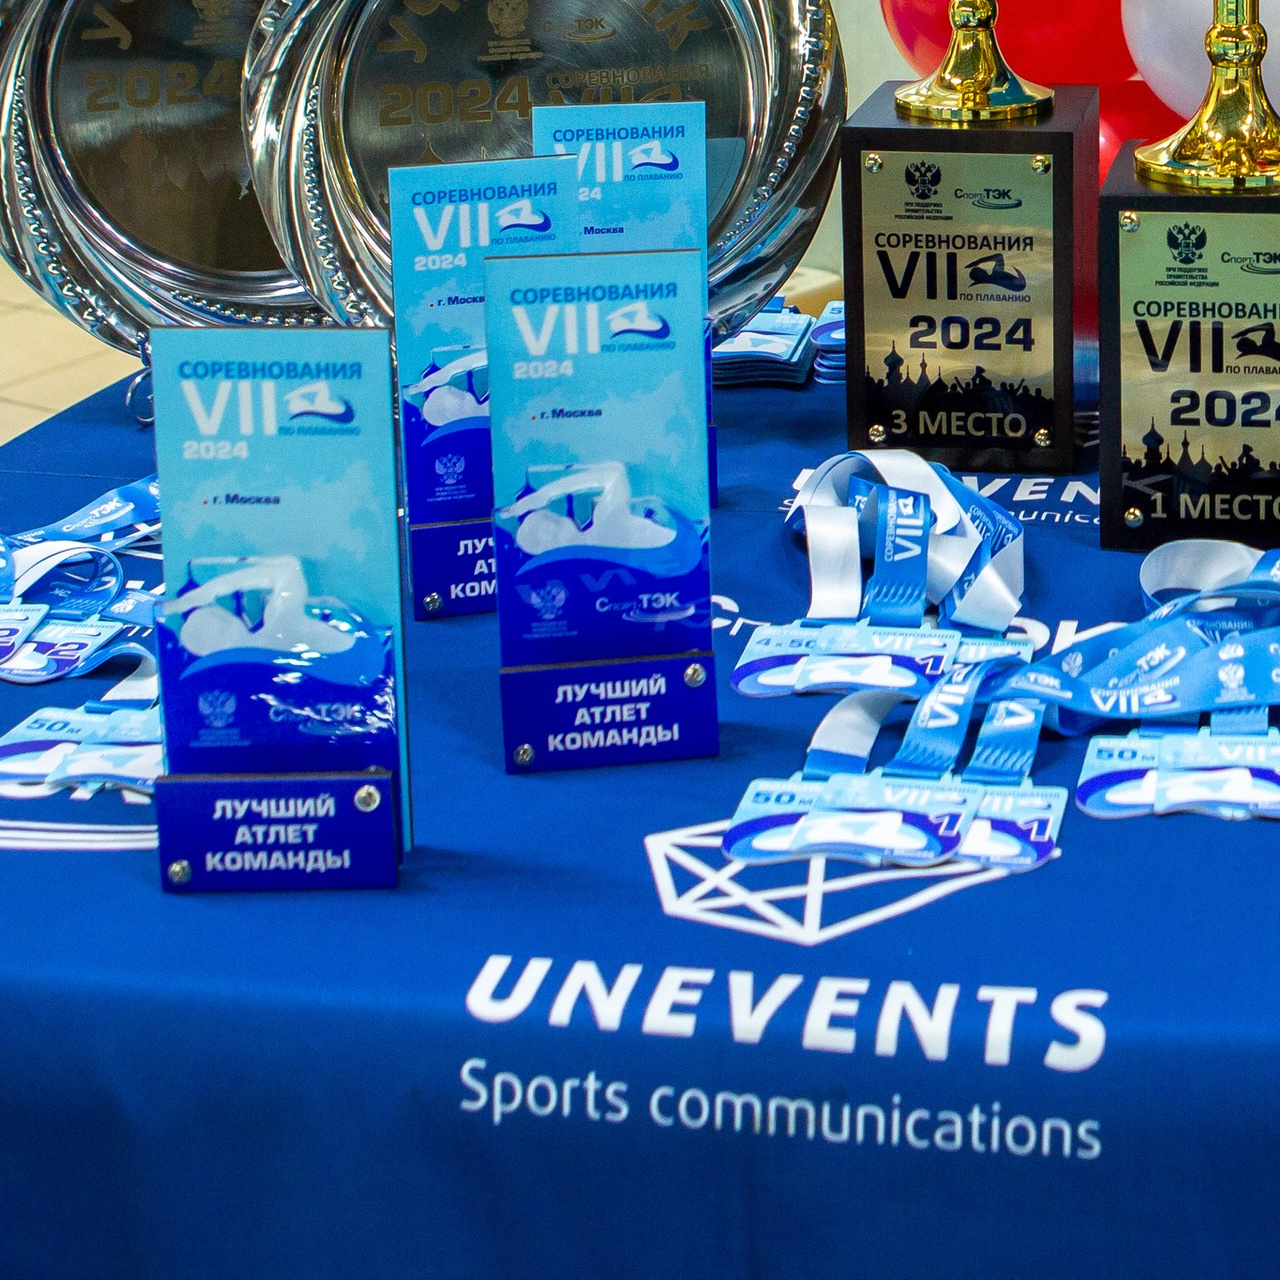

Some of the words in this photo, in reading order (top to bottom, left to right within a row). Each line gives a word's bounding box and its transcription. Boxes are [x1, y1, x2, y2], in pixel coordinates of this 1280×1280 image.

[86, 58, 237, 113] 2024
[546, 63, 710, 91] СОРЕВНОВАНИЯ
[378, 76, 533, 127] 2024
[553, 125, 685, 142] СОРЕВНОВАНИЯ
[637, 173, 683, 181] ПЛАВАНИЮ
[411, 182, 558, 206] СОРЕВНОВАНИЯ
[578, 186, 601, 201] 24
[413, 203, 490, 251] VII
[584, 225, 624, 235] Москва
[491, 237, 504, 245] ПО
[506, 233, 556, 244] ПЛАВАНИЮ
[874, 232, 1034, 251] СОРЕВНОВАНИЯ
[414, 253, 467, 271] 2024
[877, 250, 958, 300] VII
[448, 295, 485, 306] Москв
[510, 282, 678, 305] СОРЕВНОВАНИЯ
[959, 293, 973, 301] ПО
[976, 293, 1031, 303] ПЛАВАНИЮ
[511, 301, 600, 356] VII
[909, 315, 1035, 352] 2024
[1135, 319, 1224, 373] VII
[178, 361, 363, 380] СОРЕВНОВАНИЯ
[513, 359, 574, 379] 2024
[1226, 365, 1241, 374] ПО
[180, 380, 278, 436] VII
[552, 408, 602, 419] Москва
[891, 410, 907, 434] 3
[919, 410, 1027, 438] МЕСТО
[182, 441, 248, 460] 2024
[225, 494, 280, 505] Москва
[1151, 492, 1167, 519] 1
[894, 518, 925, 562] VII
[43, 641, 89, 660] 2
[755, 638, 771, 647] 4
[872, 635, 913, 649] VII
[916, 654, 946, 675] 1
[555, 673, 666, 704] ЛУЧШИЙ
[926, 684, 971, 729] VII
[1091, 688, 1139, 713] VII
[26, 718, 71, 732] 50
[574, 702, 650, 726] АТЛЕТ
[547, 723, 679, 751] КОМАНДЫ
[1096, 748, 1137, 760] 50
[1219, 745, 1265, 761] VII
[213, 793, 335, 820] ЛУЧШИЙ
[752, 791, 795, 805] 50
[884, 788, 929, 805] VII
[234, 823, 318, 845] АТЛЕТ
[930, 810, 966, 836] 1
[1018, 815, 1054, 841] 1
[205, 850, 350, 872] КОМАНДЫ
[465, 954, 1109, 1073] UNEVENTS
[459, 1058, 631, 1125] Sports
[648, 1094, 1102, 1160] communications
